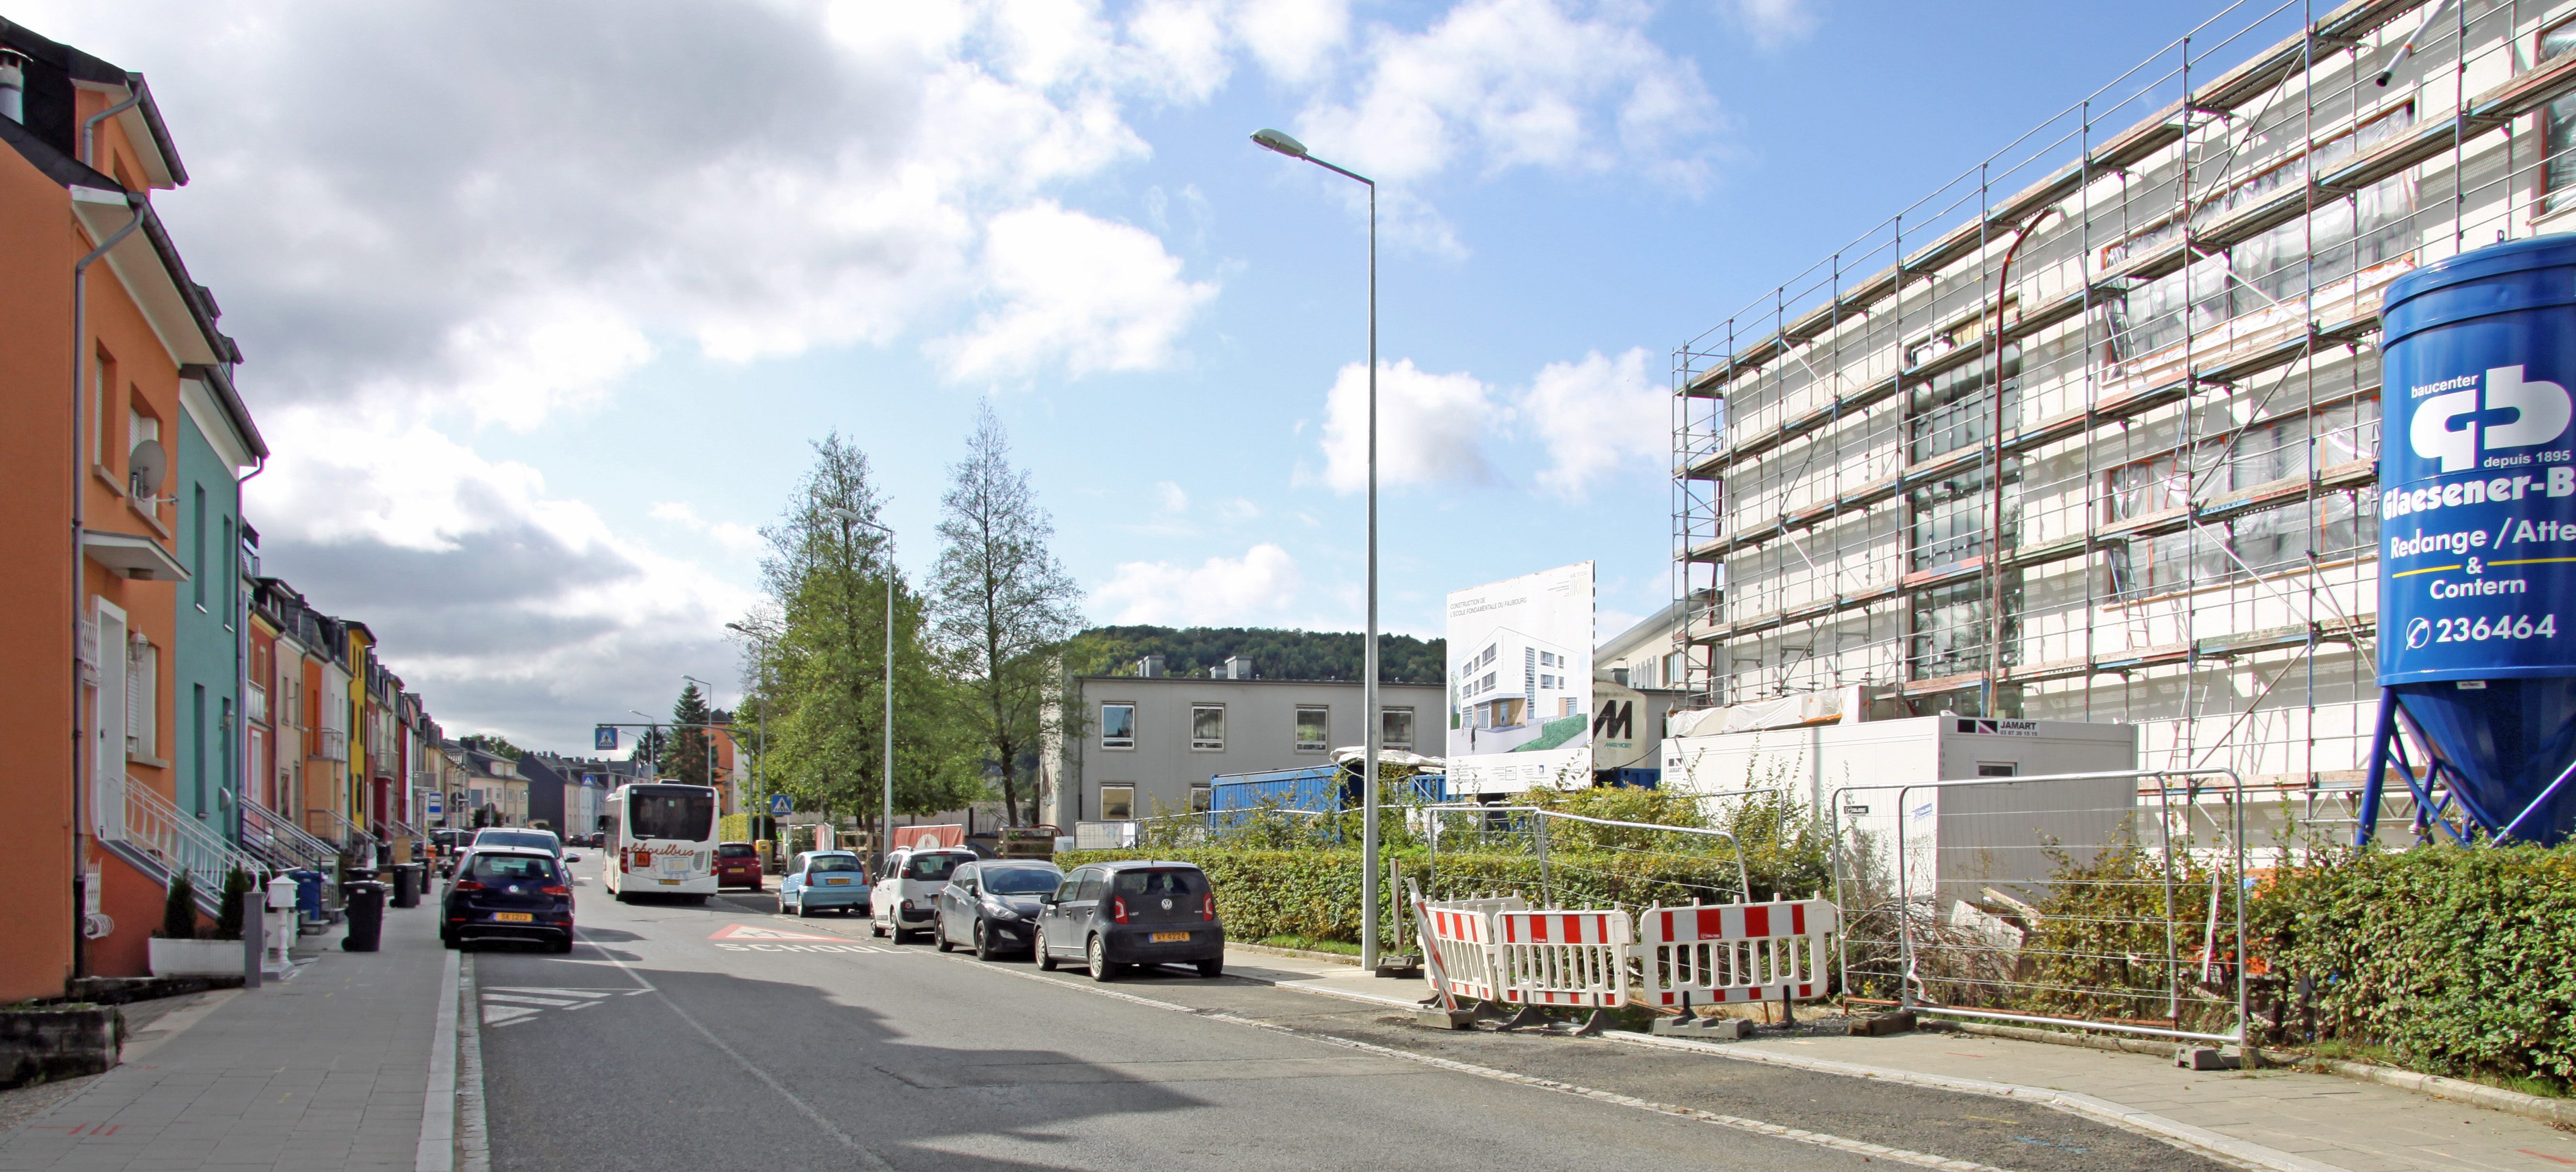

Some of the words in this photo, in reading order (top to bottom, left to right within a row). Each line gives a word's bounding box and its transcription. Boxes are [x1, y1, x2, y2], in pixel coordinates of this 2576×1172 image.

[2411, 374, 2478, 398] baucenter
[2484, 454, 2530, 468] depuis
[2536, 450, 2569, 462] 1895
[2391, 529, 2487, 559] Redange
[2466, 556, 2482, 574] &
[2430, 577, 2526, 600] Contern
[1450, 598, 1479, 609] CONSTRUCTION
[1466, 602, 1497, 614] FONDAMENTALE
[1504, 597, 1527, 607] FAUBOURG
[2436, 614, 2556, 643] 236464
[2000, 721, 2036, 730] JAMART
[715, 943, 912, 954] SCHOUL
